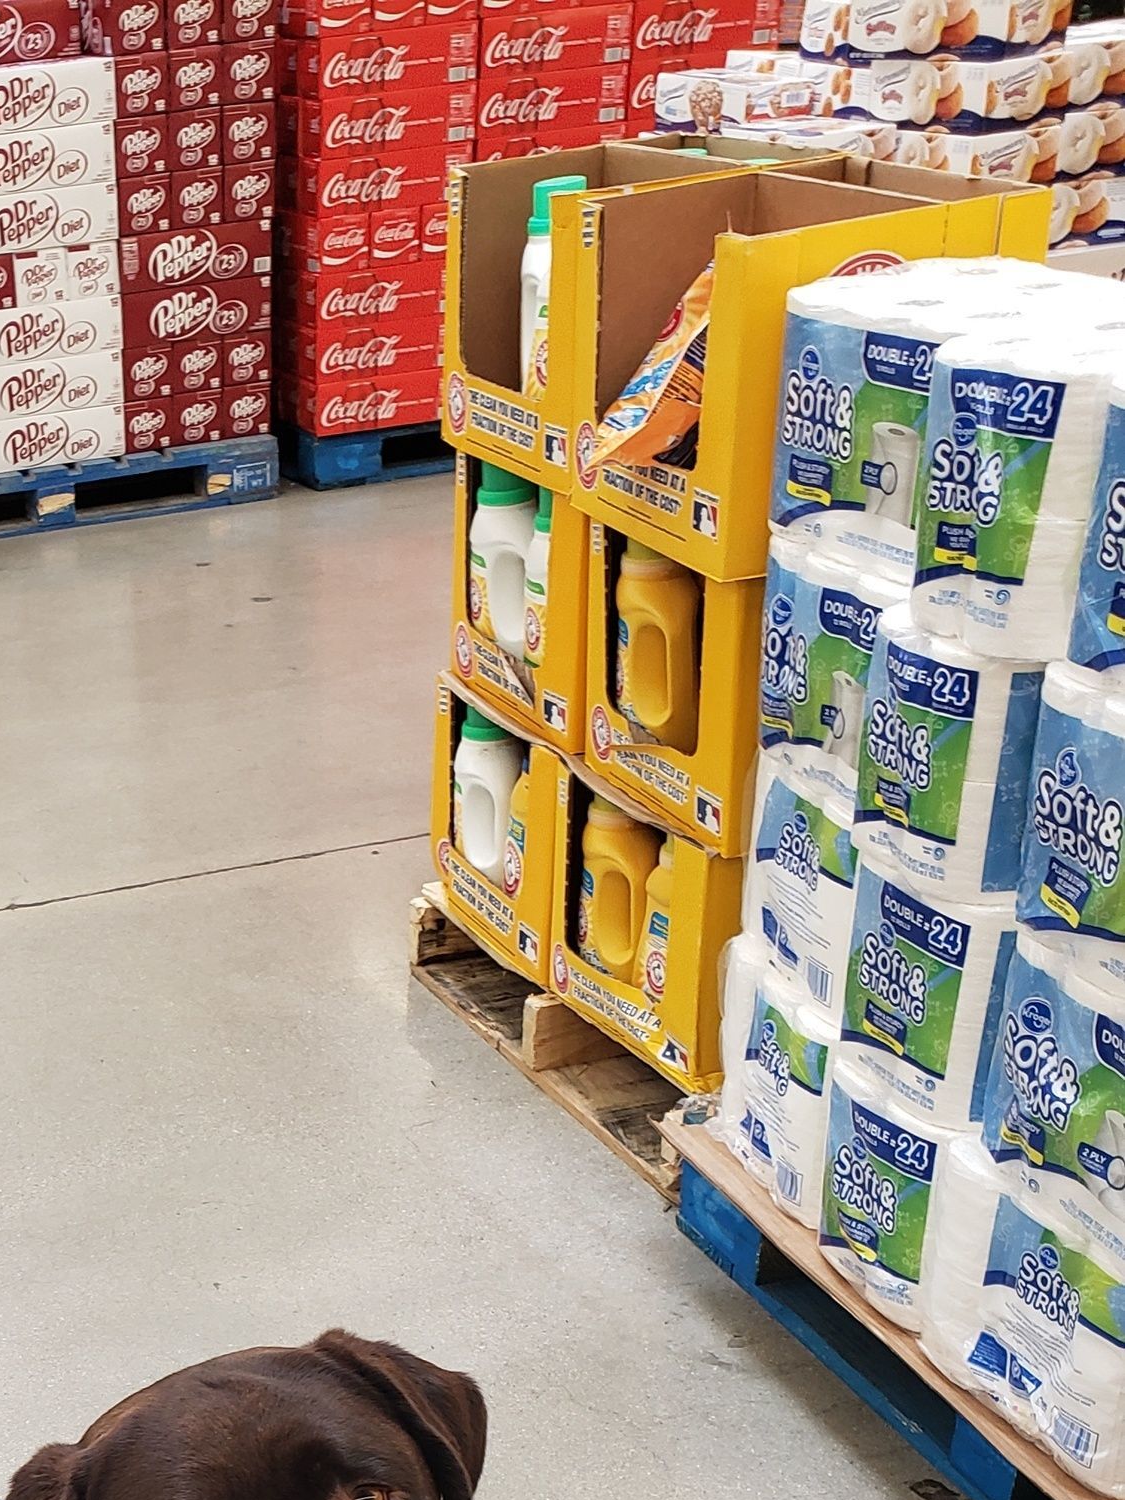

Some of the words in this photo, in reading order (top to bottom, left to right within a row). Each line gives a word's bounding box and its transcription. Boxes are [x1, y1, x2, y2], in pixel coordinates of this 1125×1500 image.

[26, 33, 42, 49] 23
[10, 77, 33, 98] Dr
[58, 96, 81, 117] Diet
[9, 140, 32, 163] Dr
[57, 159, 81, 179] Diet
[14, 200, 37, 222] Dr
[61, 217, 84, 237] Diet
[152, 240, 211, 282] Pepper
[171, 235, 196, 254] Dr
[221, 255, 234, 269] 23
[154, 298, 211, 338] Pepper
[172, 292, 197, 311] Dr
[222, 311, 235, 325] 23
[3, 319, 59, 358] Pepper
[21, 314, 43, 332] Dr
[67, 330, 89, 348] Diet
[866, 344, 909, 366] DOUBLE
[6, 374, 60, 412] Pepper
[22, 368, 44, 387] Dr
[69, 383, 90, 402] Diet
[786, 376, 835, 424] Soft
[835, 388, 852, 429] &
[1007, 382, 1055, 425] 24
[10, 427, 63, 465] Pepper
[26, 422, 48, 441] Dr
[72, 436, 93, 455] Diet
[783, 415, 851, 457] STRONG
[978, 454, 1002, 494] &
[932, 668, 970, 706] 24
[912, 728, 928, 763] &
[1036, 774, 1097, 837] Soft
[1099, 805, 1121, 850] &
[781, 826, 815, 865] Soft
[1035, 816, 1117, 880] STRONG
[884, 895, 924, 927] DOUBLE
[928, 916, 962, 954] 24
[864, 936, 908, 987] Soft
[909, 968, 925, 999] &
[860, 966, 924, 1022] STRONG
[617, 996, 638, 1017] NEED
[639, 1010, 653, 1023] AT
[653, 1018, 662, 1028] A
[1023, 1005, 1052, 1029] Kroger
[1052, 1062, 1077, 1105] &
[895, 1134, 928, 1170] 24
[1082, 1148, 1089, 1157] 2
[1090, 1152, 1107, 1164] PLY
[835, 1148, 878, 1198] Soft
[880, 1181, 895, 1211] &
[832, 1175, 894, 1231] STRONG
